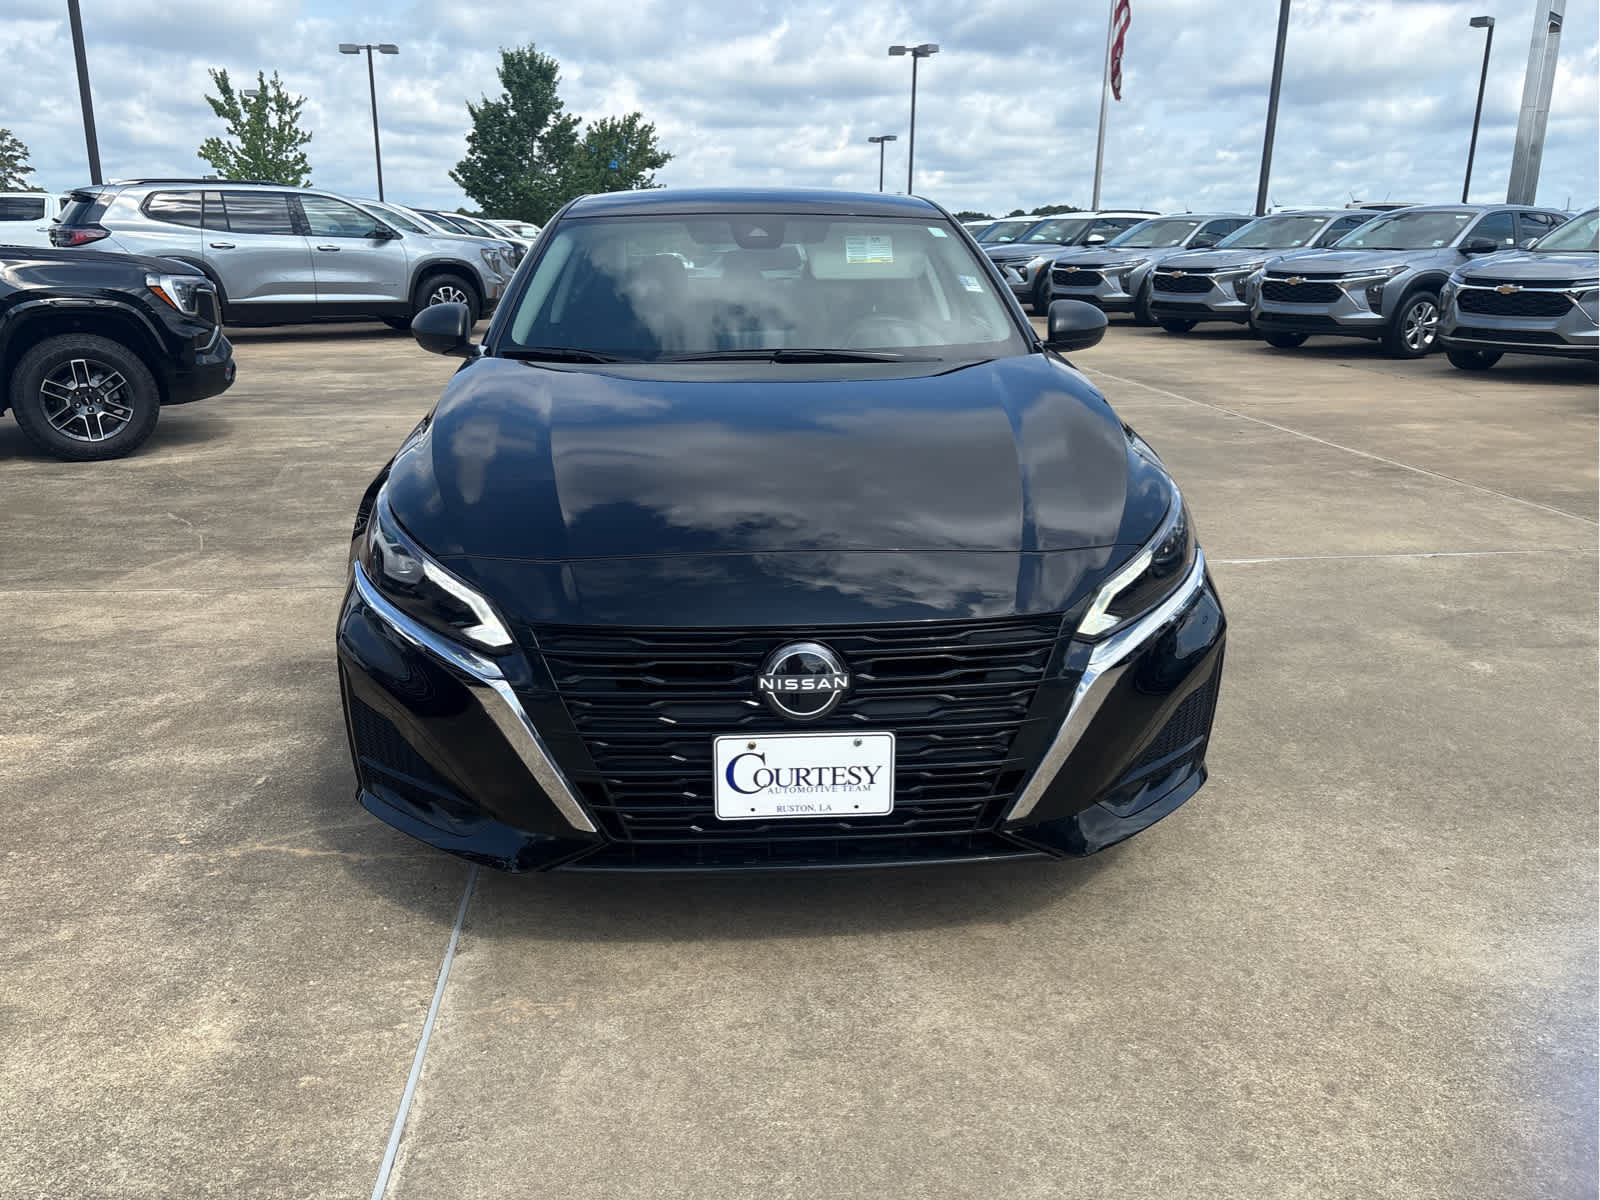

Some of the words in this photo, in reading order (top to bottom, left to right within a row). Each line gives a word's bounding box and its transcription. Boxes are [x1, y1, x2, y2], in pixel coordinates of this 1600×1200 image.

[760, 677, 848, 690] NISSAN
[725, 752, 882, 794] COURTESY
[767, 785, 838, 794] AUTOMOTIVE
[843, 784, 871, 793] TEAM
[776, 804, 817, 813] RUSTON,
[819, 803, 832, 812] LA
